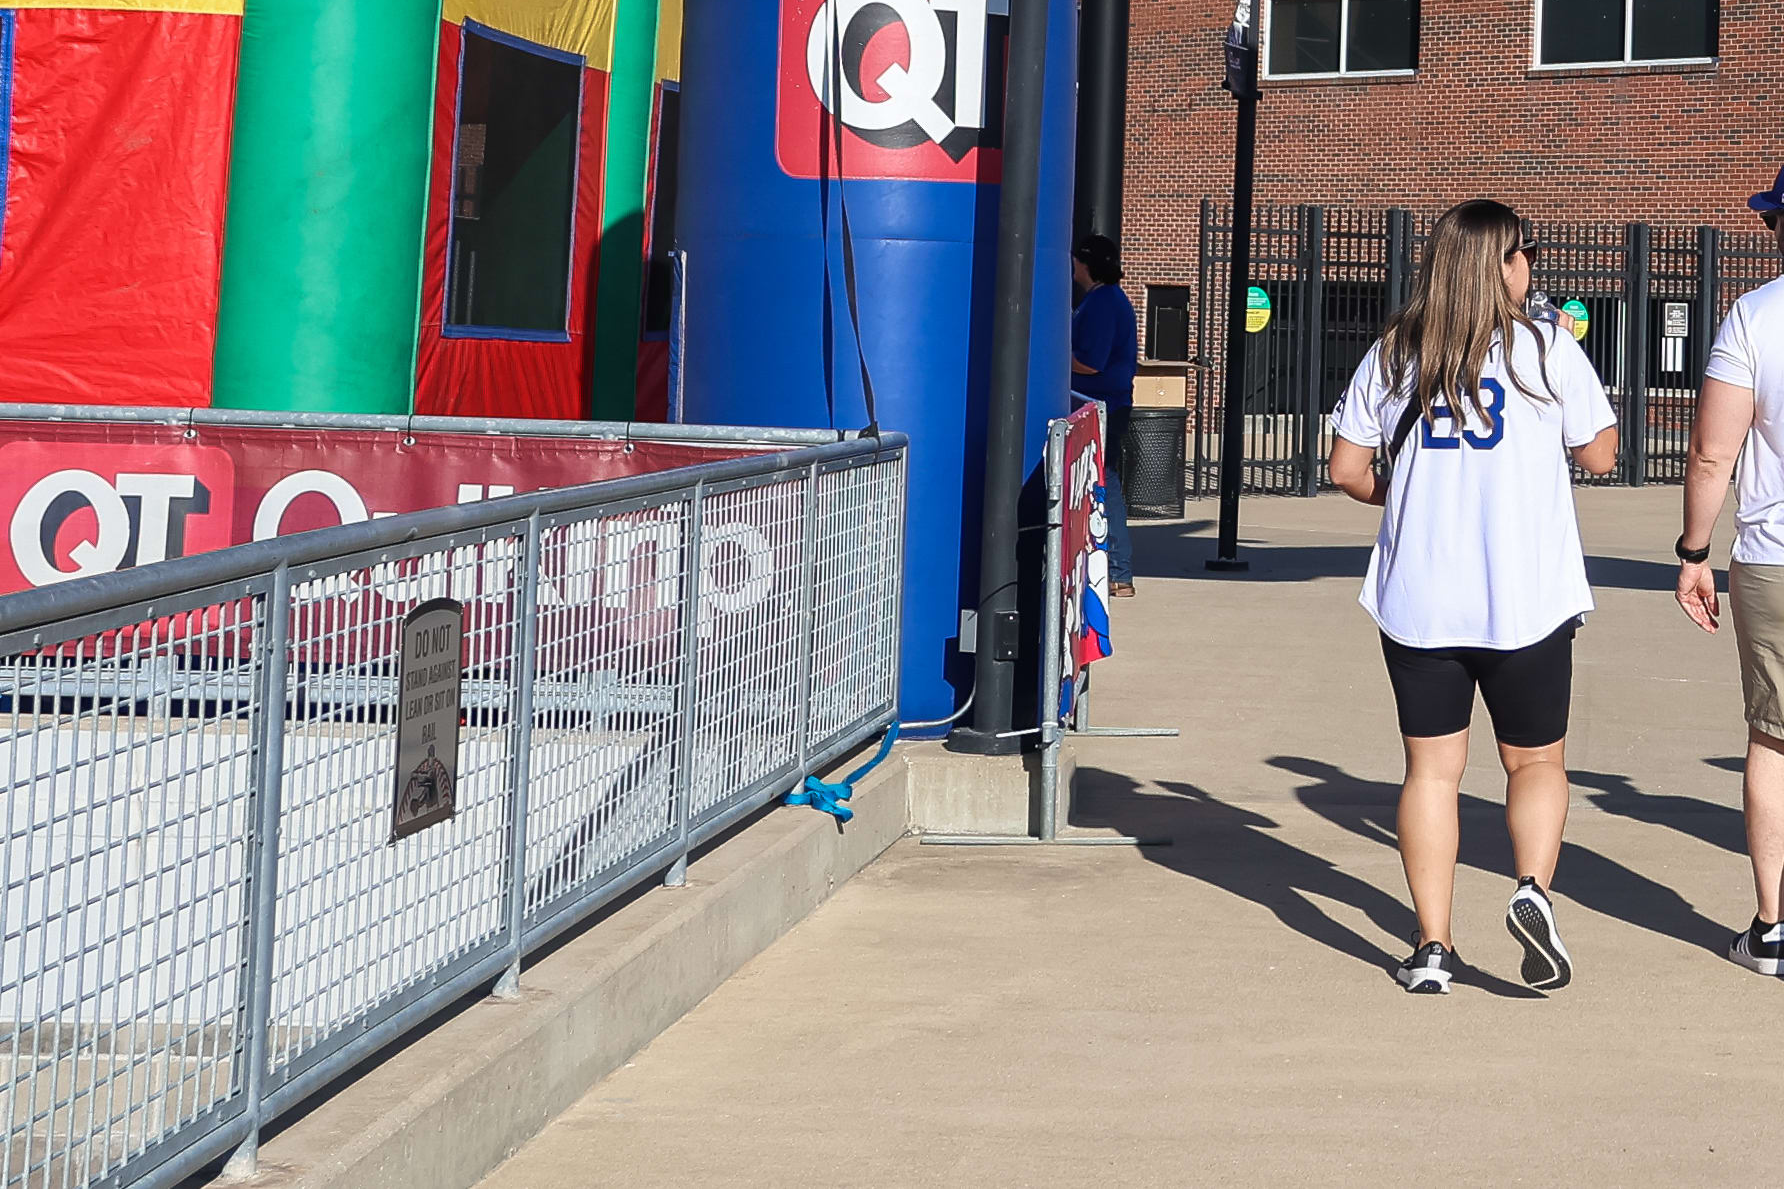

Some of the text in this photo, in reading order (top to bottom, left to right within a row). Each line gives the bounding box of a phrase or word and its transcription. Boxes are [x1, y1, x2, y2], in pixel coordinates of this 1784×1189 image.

[10, 469, 196, 588] QT
[415, 624, 452, 659] DO NOT
[405, 659, 456, 692] STAND AGAINST
[405, 687, 456, 721] LEAN OR SIT ON
[421, 722, 438, 746] RAIL
